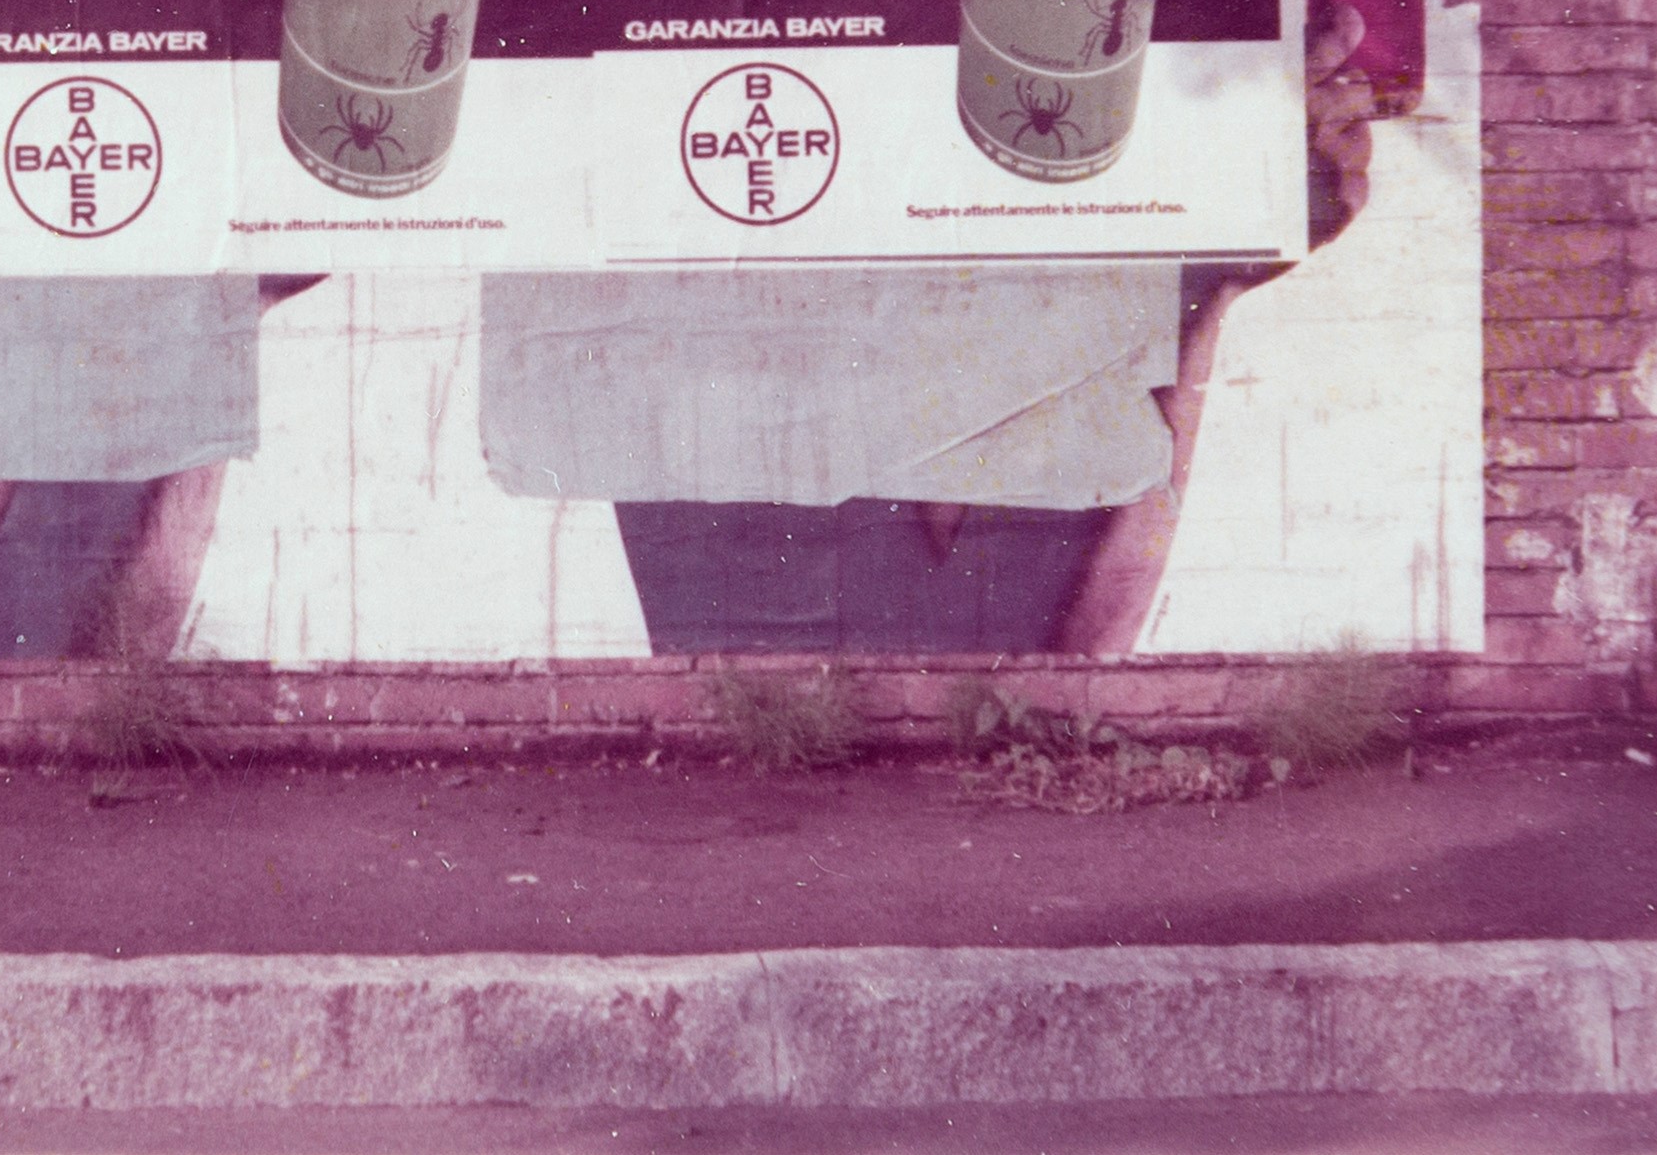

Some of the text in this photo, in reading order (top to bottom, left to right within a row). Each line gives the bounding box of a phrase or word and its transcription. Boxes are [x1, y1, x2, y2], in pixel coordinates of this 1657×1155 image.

[109, 31, 207, 52] BAYER
[625, 16, 885, 41] GARANZIA BAYER
[691, 130, 830, 158] BAYER
[15, 144, 153, 171] BAYER
